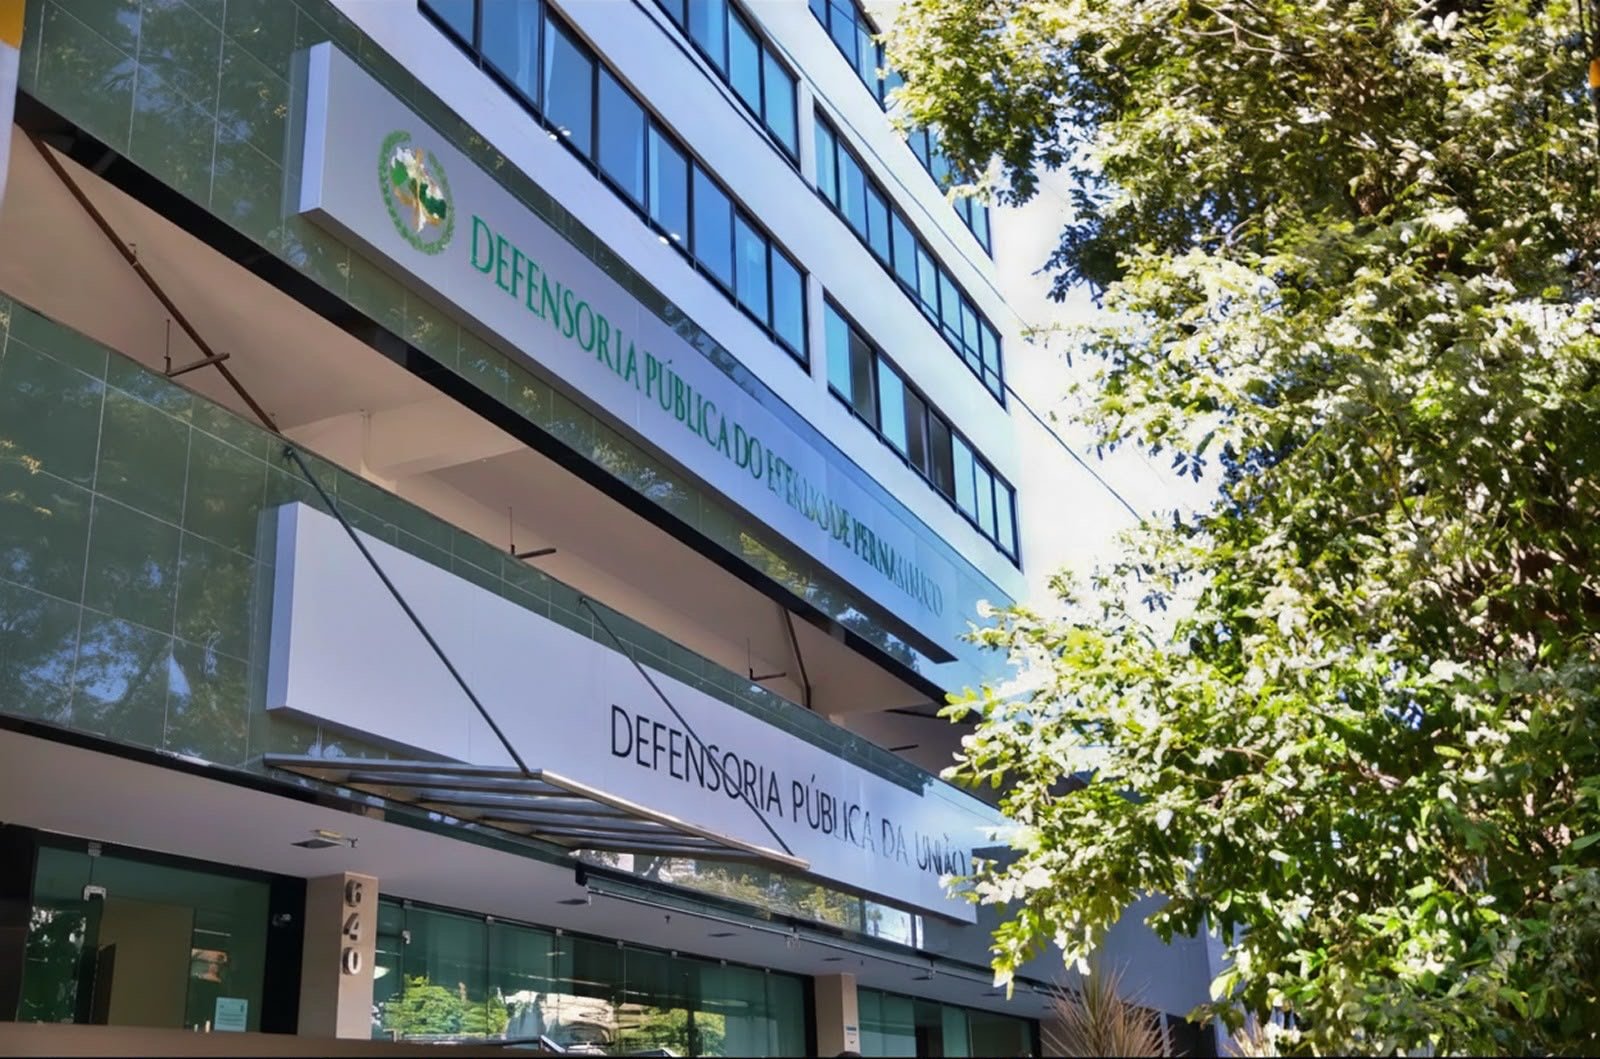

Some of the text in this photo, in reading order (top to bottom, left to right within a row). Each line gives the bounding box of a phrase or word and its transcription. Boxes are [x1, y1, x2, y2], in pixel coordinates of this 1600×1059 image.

[470, 214, 641, 391] DEFENSORIA
[645, 351, 731, 460] PÚBLICA
[733, 422, 763, 480] DO
[610, 703, 784, 818] DEFENSORIA
[792, 774, 876, 853] PÚBLICA
[882, 818, 909, 867] DA
[342, 878, 362, 976] 640
